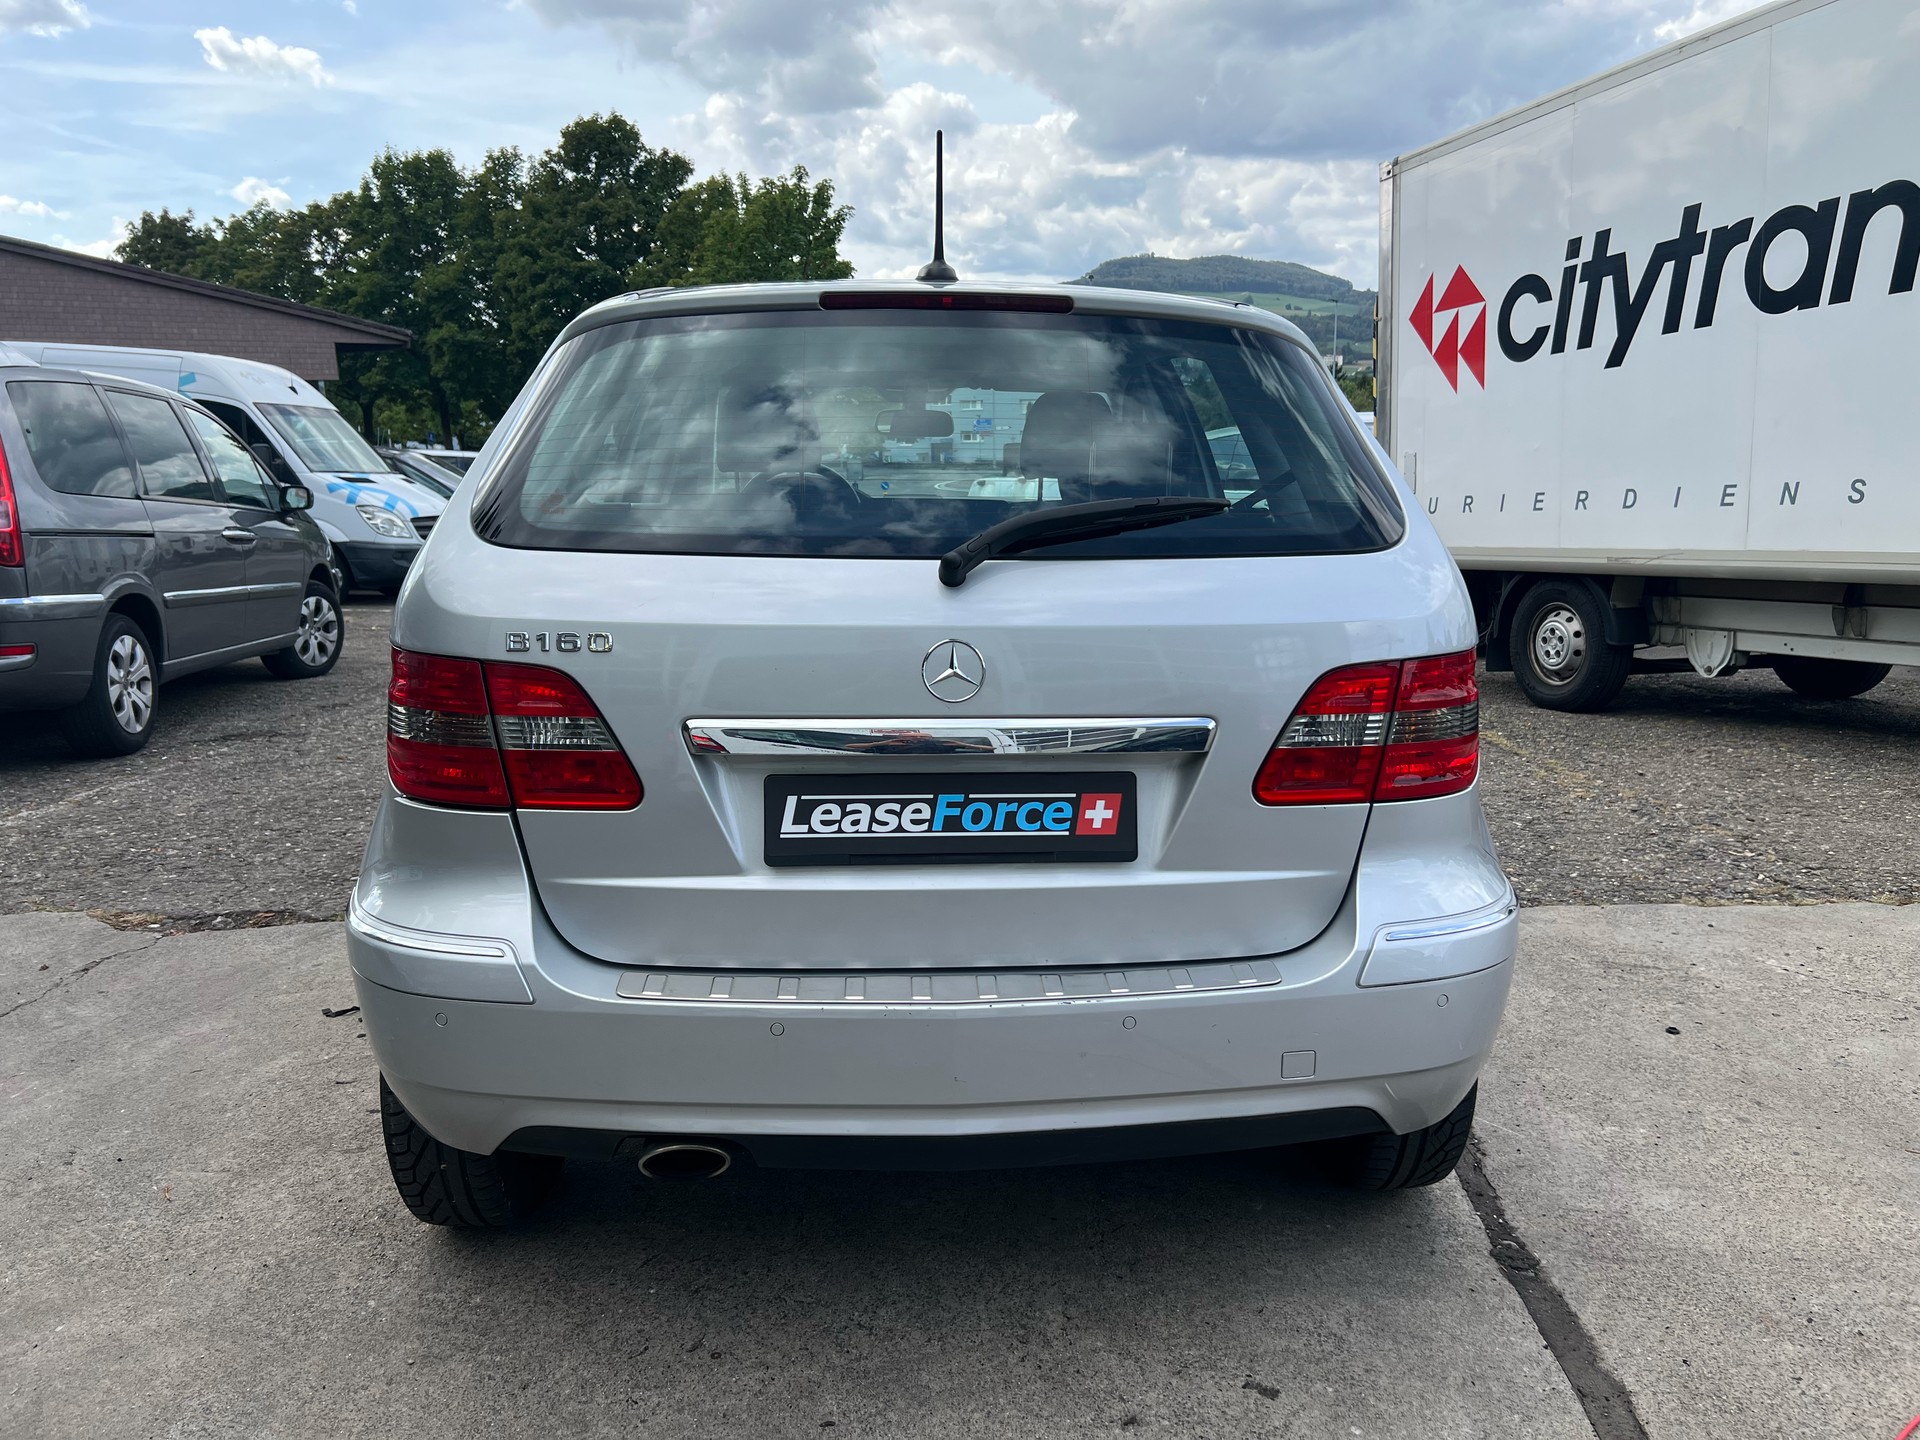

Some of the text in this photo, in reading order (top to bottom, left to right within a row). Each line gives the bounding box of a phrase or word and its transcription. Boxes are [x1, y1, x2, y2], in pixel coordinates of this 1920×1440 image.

[1497, 179, 1920, 370] citytran
[506, 631, 613, 652] B160
[780, 793, 1073, 834] LeaseForce
